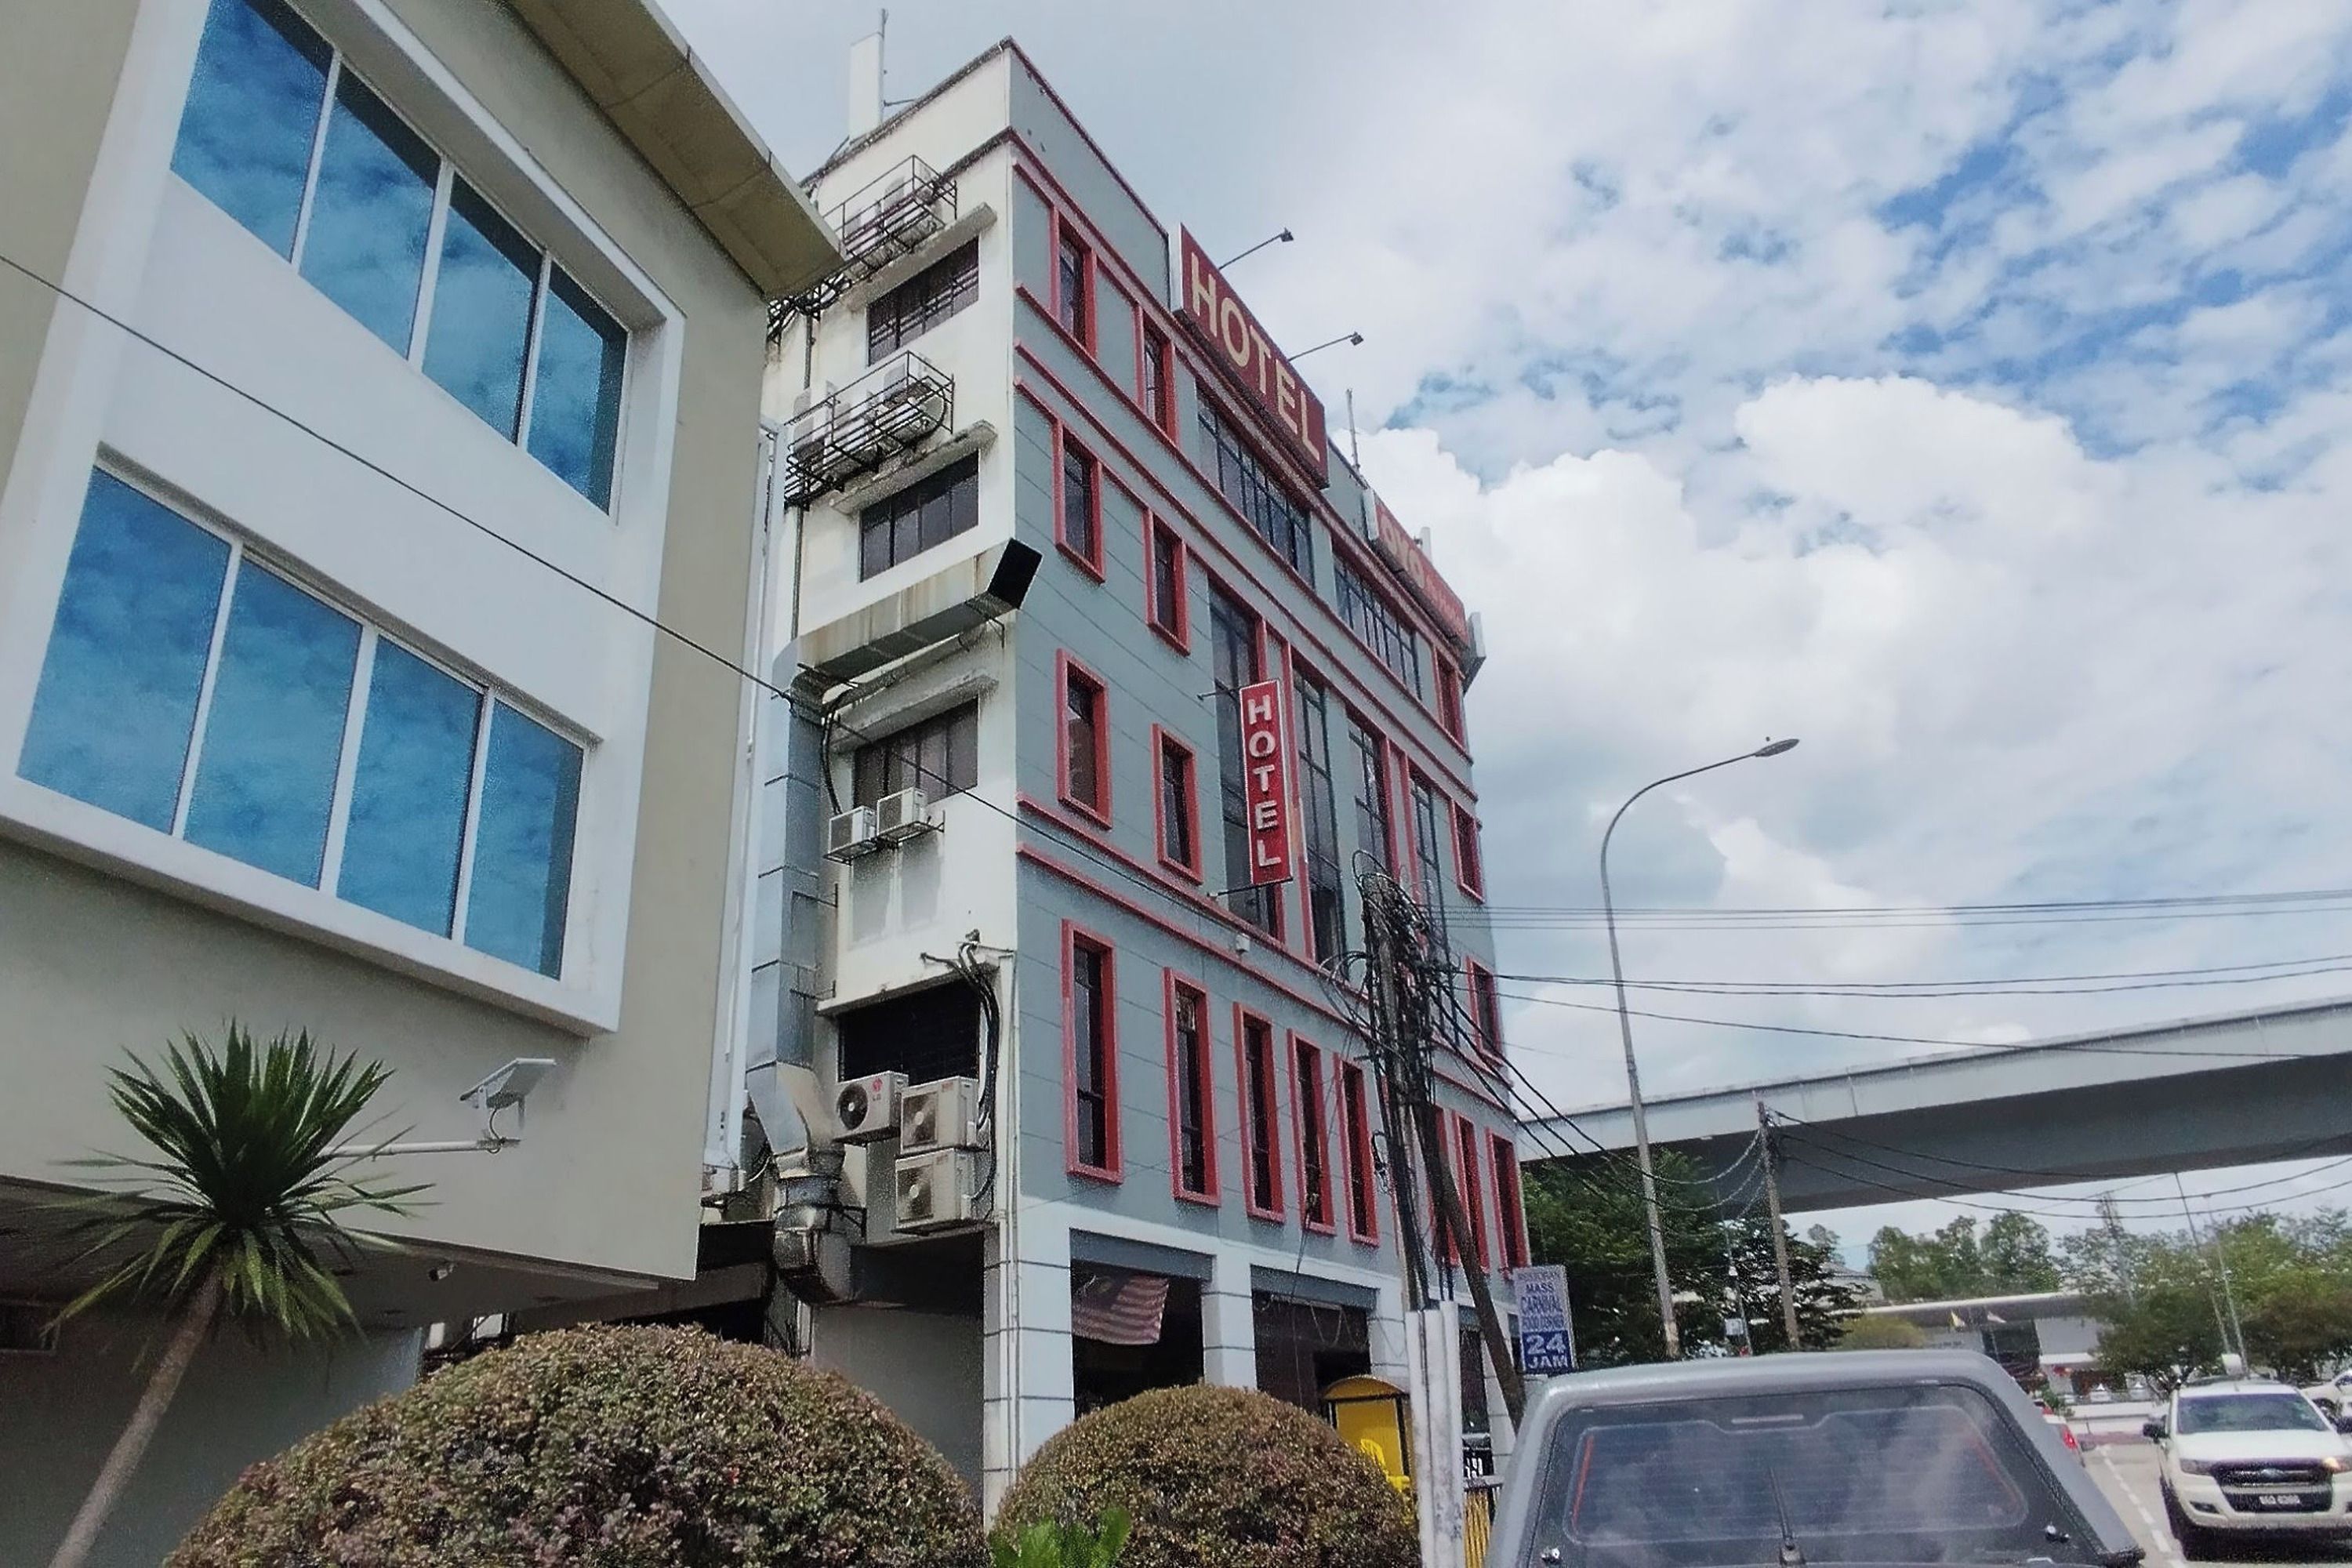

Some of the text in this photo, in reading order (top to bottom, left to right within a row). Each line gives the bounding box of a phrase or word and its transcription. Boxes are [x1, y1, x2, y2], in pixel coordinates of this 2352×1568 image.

[1191, 252, 1320, 462] HOTEL
[1247, 695, 1281, 867] HOTEL
[1525, 1283, 1555, 1294] MASS
[1526, 1334, 1566, 1355] 24
[1527, 1355, 1568, 1369] JAM
